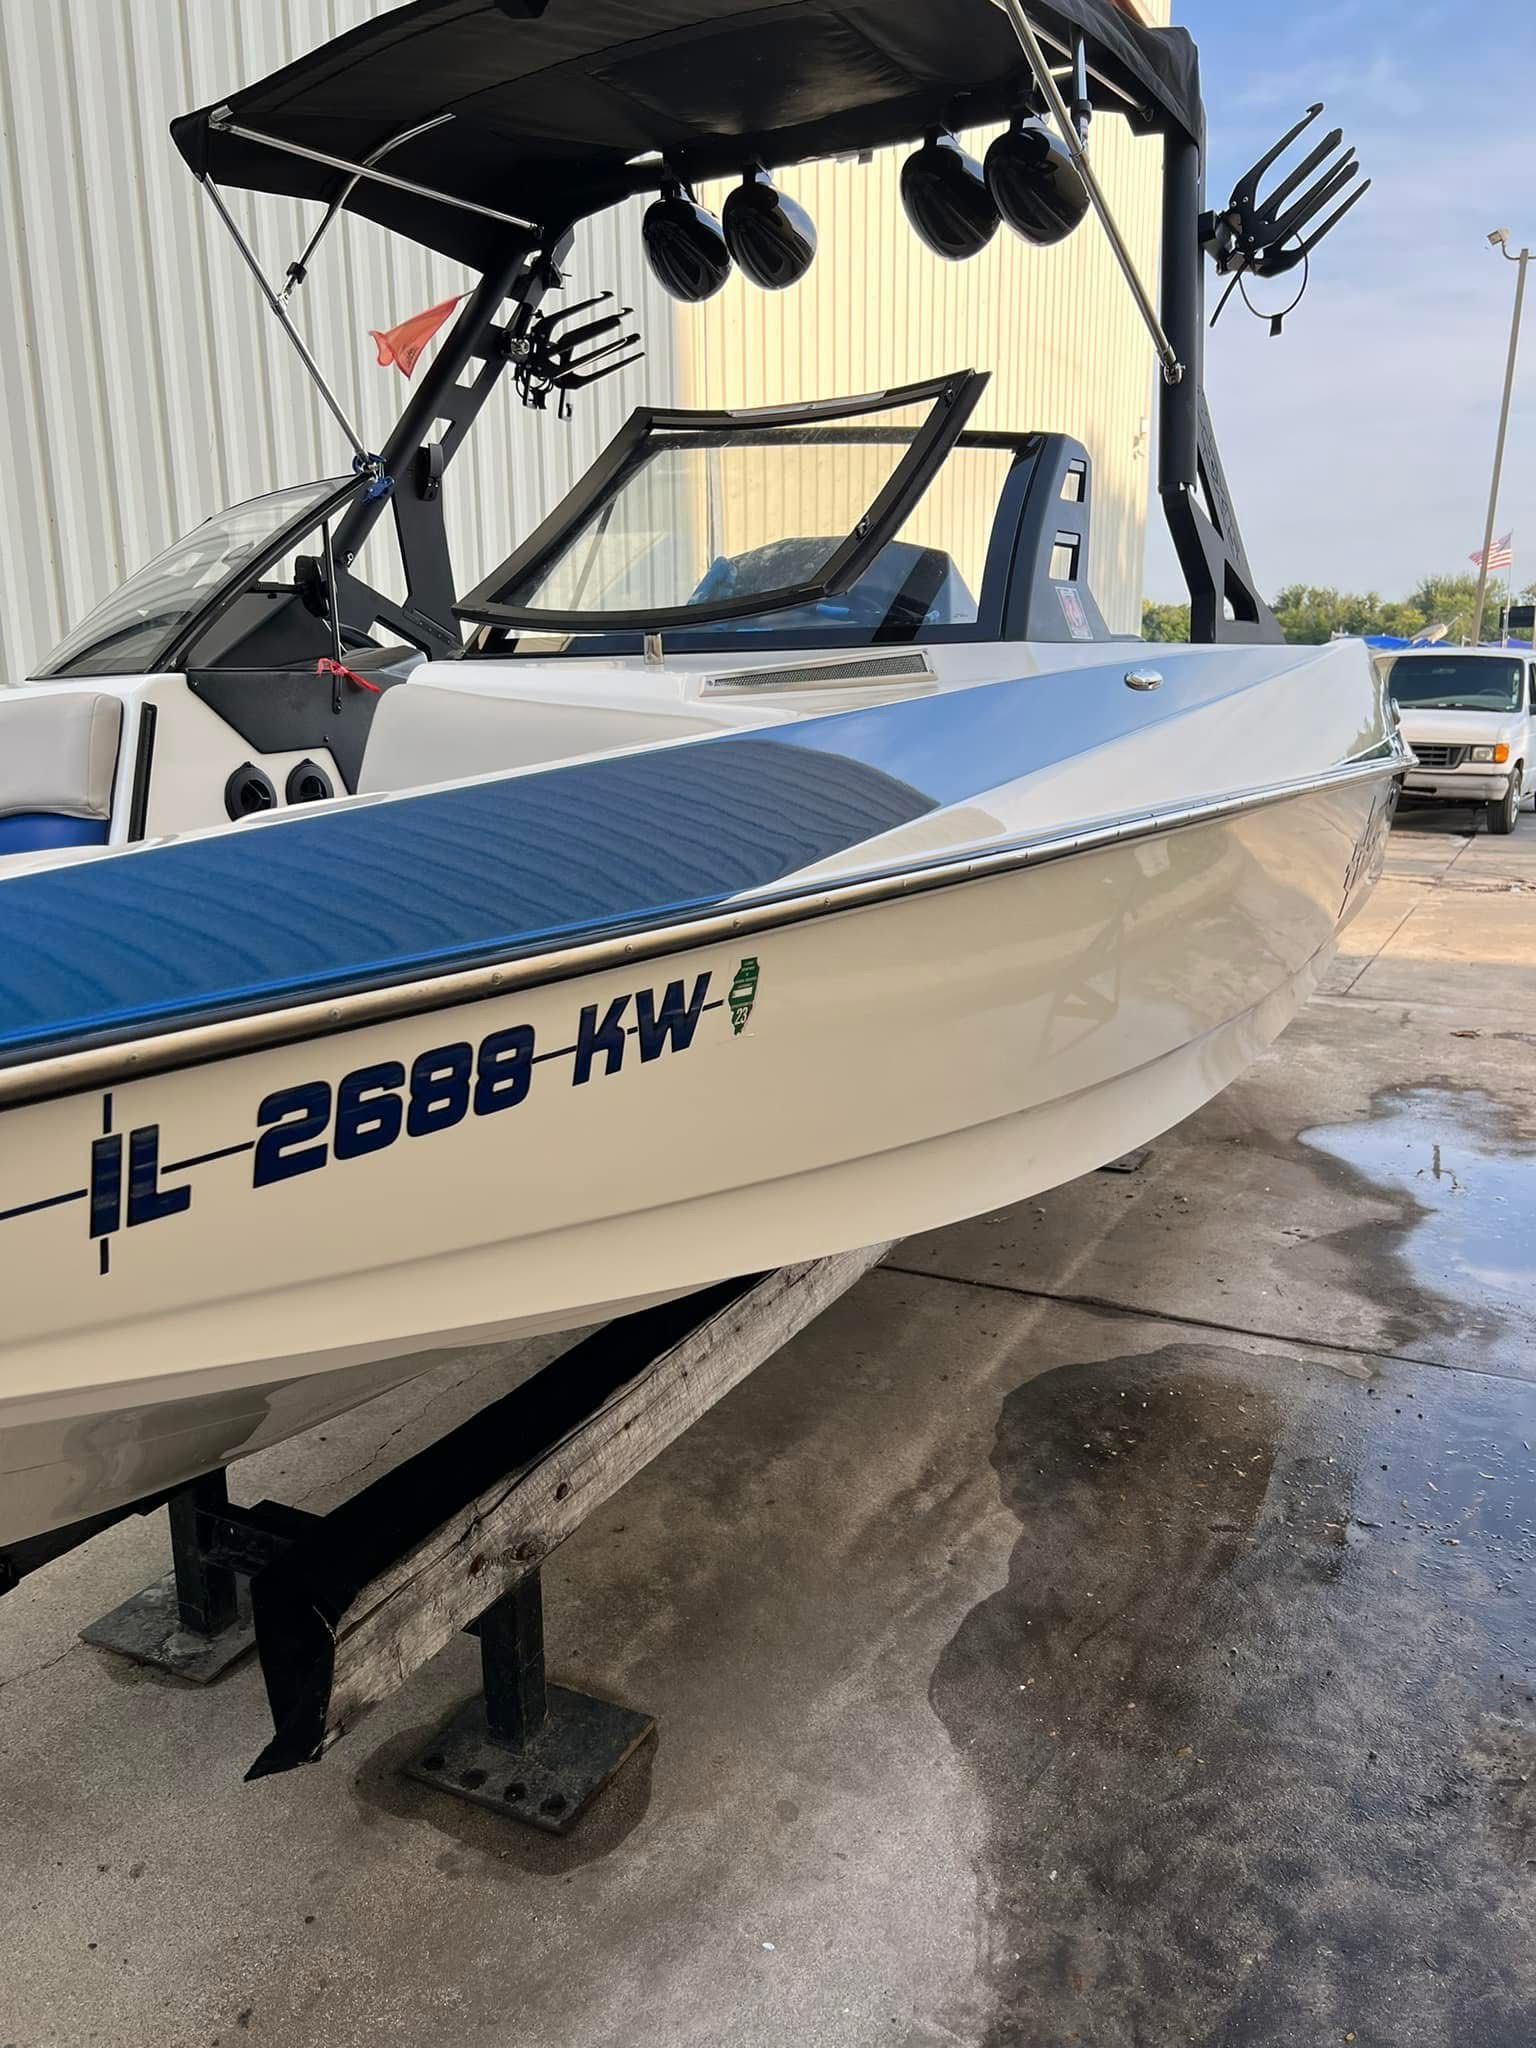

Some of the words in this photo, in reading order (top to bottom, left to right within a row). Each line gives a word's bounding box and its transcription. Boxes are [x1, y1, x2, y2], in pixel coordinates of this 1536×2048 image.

[735, 1007, 749, 1025] 23
[89, 1124, 192, 1239] IL
[253, 1024, 535, 1189] 2688
[572, 971, 713, 1087] KW
